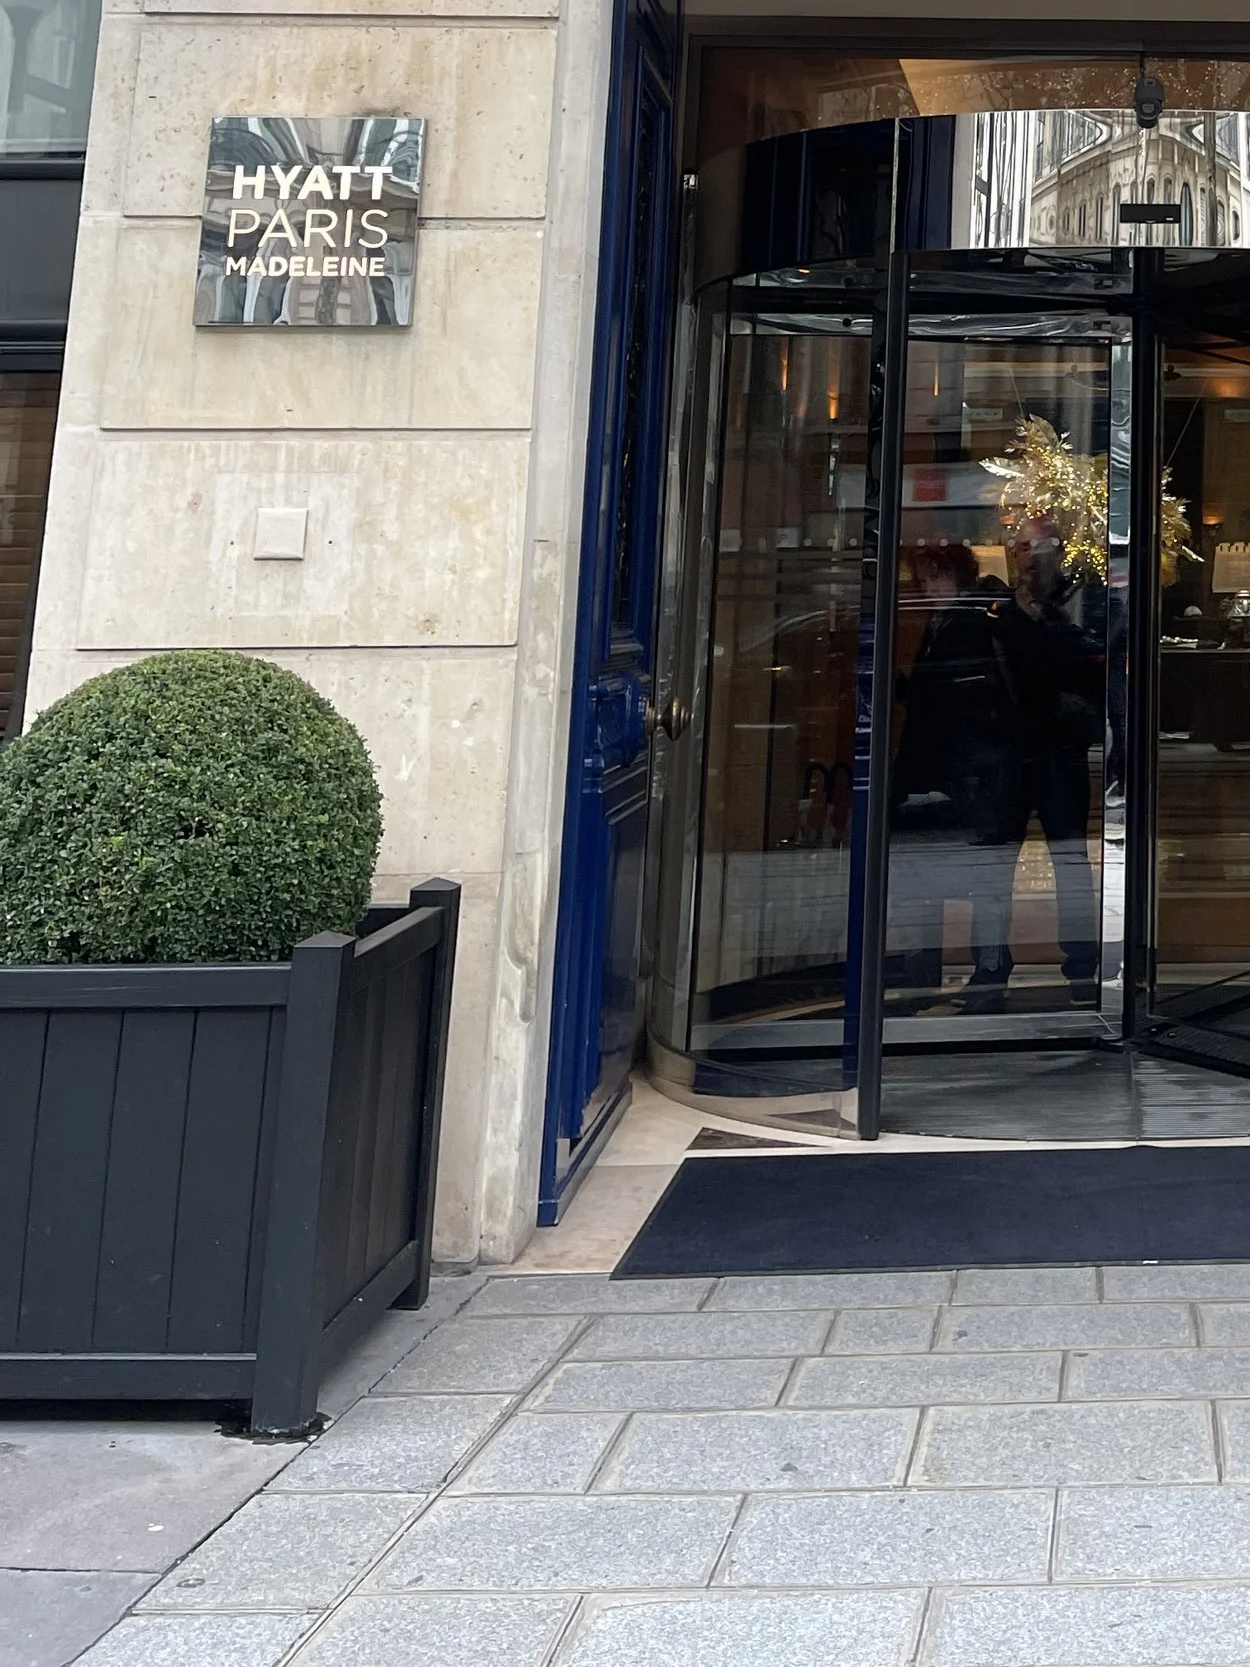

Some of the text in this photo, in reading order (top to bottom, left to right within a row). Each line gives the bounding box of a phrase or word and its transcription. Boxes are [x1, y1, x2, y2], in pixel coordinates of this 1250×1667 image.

[232, 165, 393, 200] HYATT
[227, 209, 388, 248] PARIS
[225, 256, 386, 277] MADELEINE
